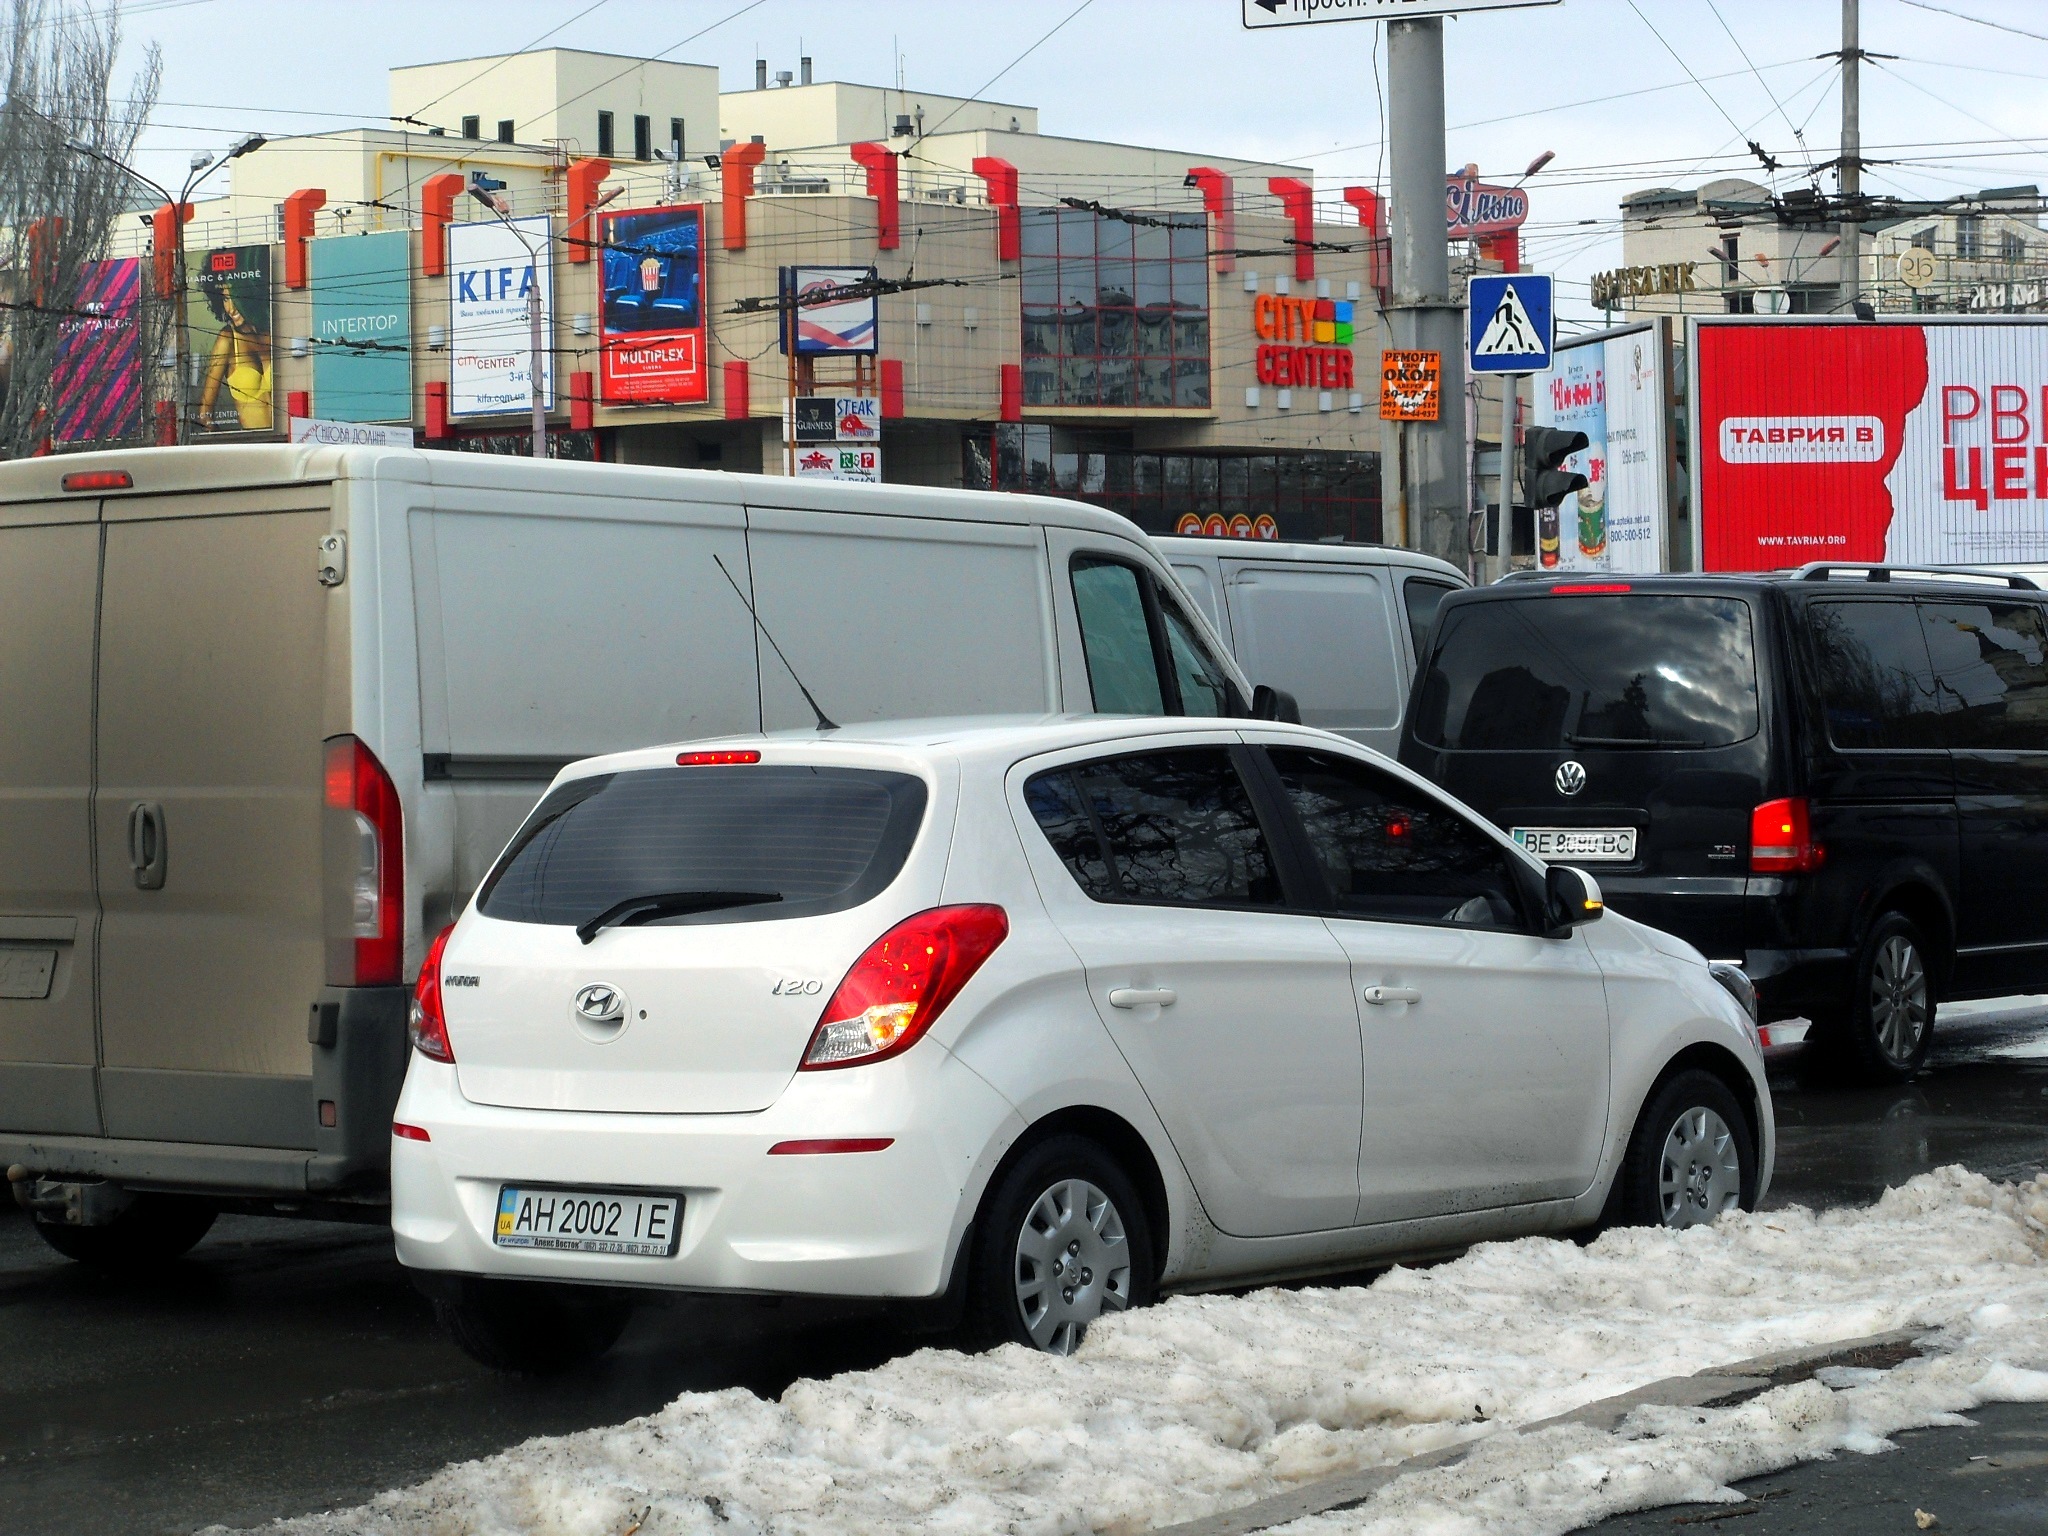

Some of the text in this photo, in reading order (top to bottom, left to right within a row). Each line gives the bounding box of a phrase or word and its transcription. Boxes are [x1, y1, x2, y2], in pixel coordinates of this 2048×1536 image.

[217, 273, 223, 281] &
[459, 265, 533, 303] KIFA
[322, 315, 398, 334] INTERTOP
[1255, 293, 1317, 342] CITY
[457, 355, 516, 370] CITY CENTER
[620, 348, 684, 364] MULTIPLEX
[1385, 352, 1438, 363] РЕМОНТ
[1256, 343, 1354, 389] CENTER
[1384, 368, 1437, 381] ОКОН
[837, 398, 873, 416] STEAK
[1942, 385, 2048, 444] РВ
[797, 420, 833, 431] GUINNESS
[1730, 427, 1845, 444] ТАВРИЯ
[1757, 536, 1847, 546] WWW.TAVRIAV.ORG
[1525, 833, 1552, 854] BE
[500, 1221, 512, 1231] UA
[515, 1196, 670, 1241] AH 2002 IE
